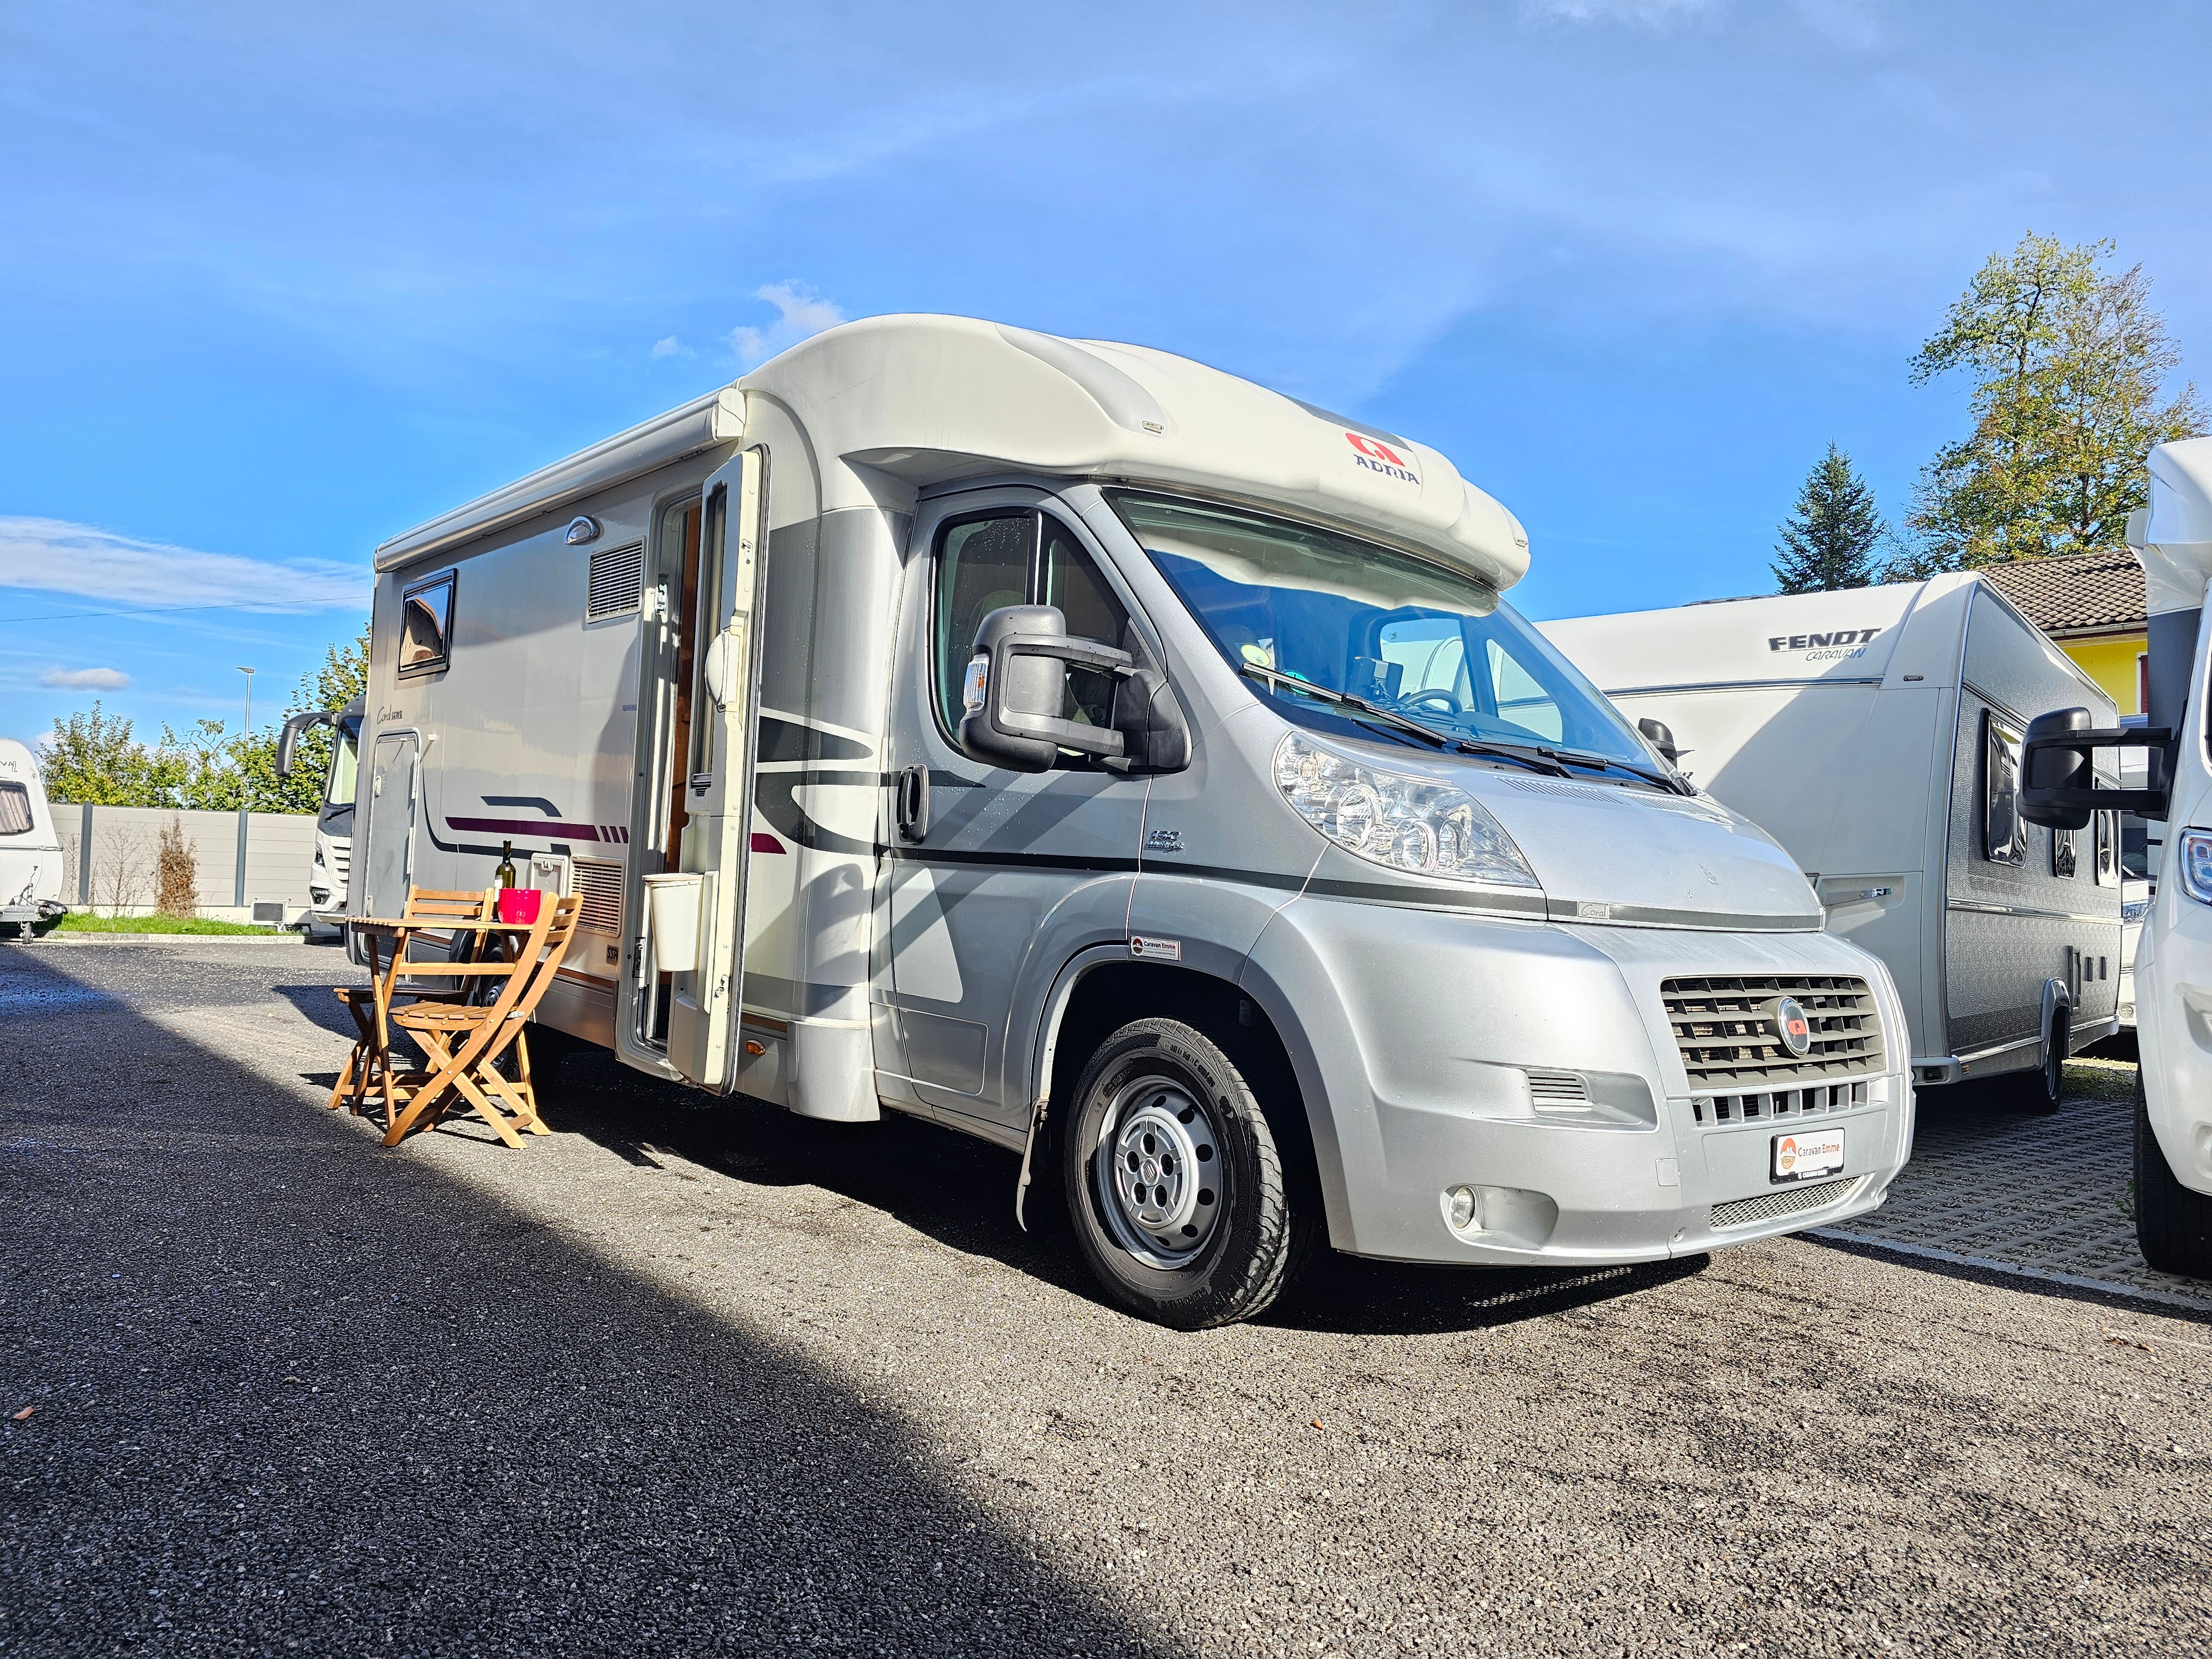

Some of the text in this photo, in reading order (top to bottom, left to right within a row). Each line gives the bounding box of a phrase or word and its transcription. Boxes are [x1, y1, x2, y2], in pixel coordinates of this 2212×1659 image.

[1353, 453, 1421, 485] ADRIA
[1768, 628, 1882, 651] FENDT
[1805, 647, 1866, 661] CARAVAN
[1581, 904, 1606, 917] Coral
[1798, 1144, 1840, 1157] Caravan Emme
